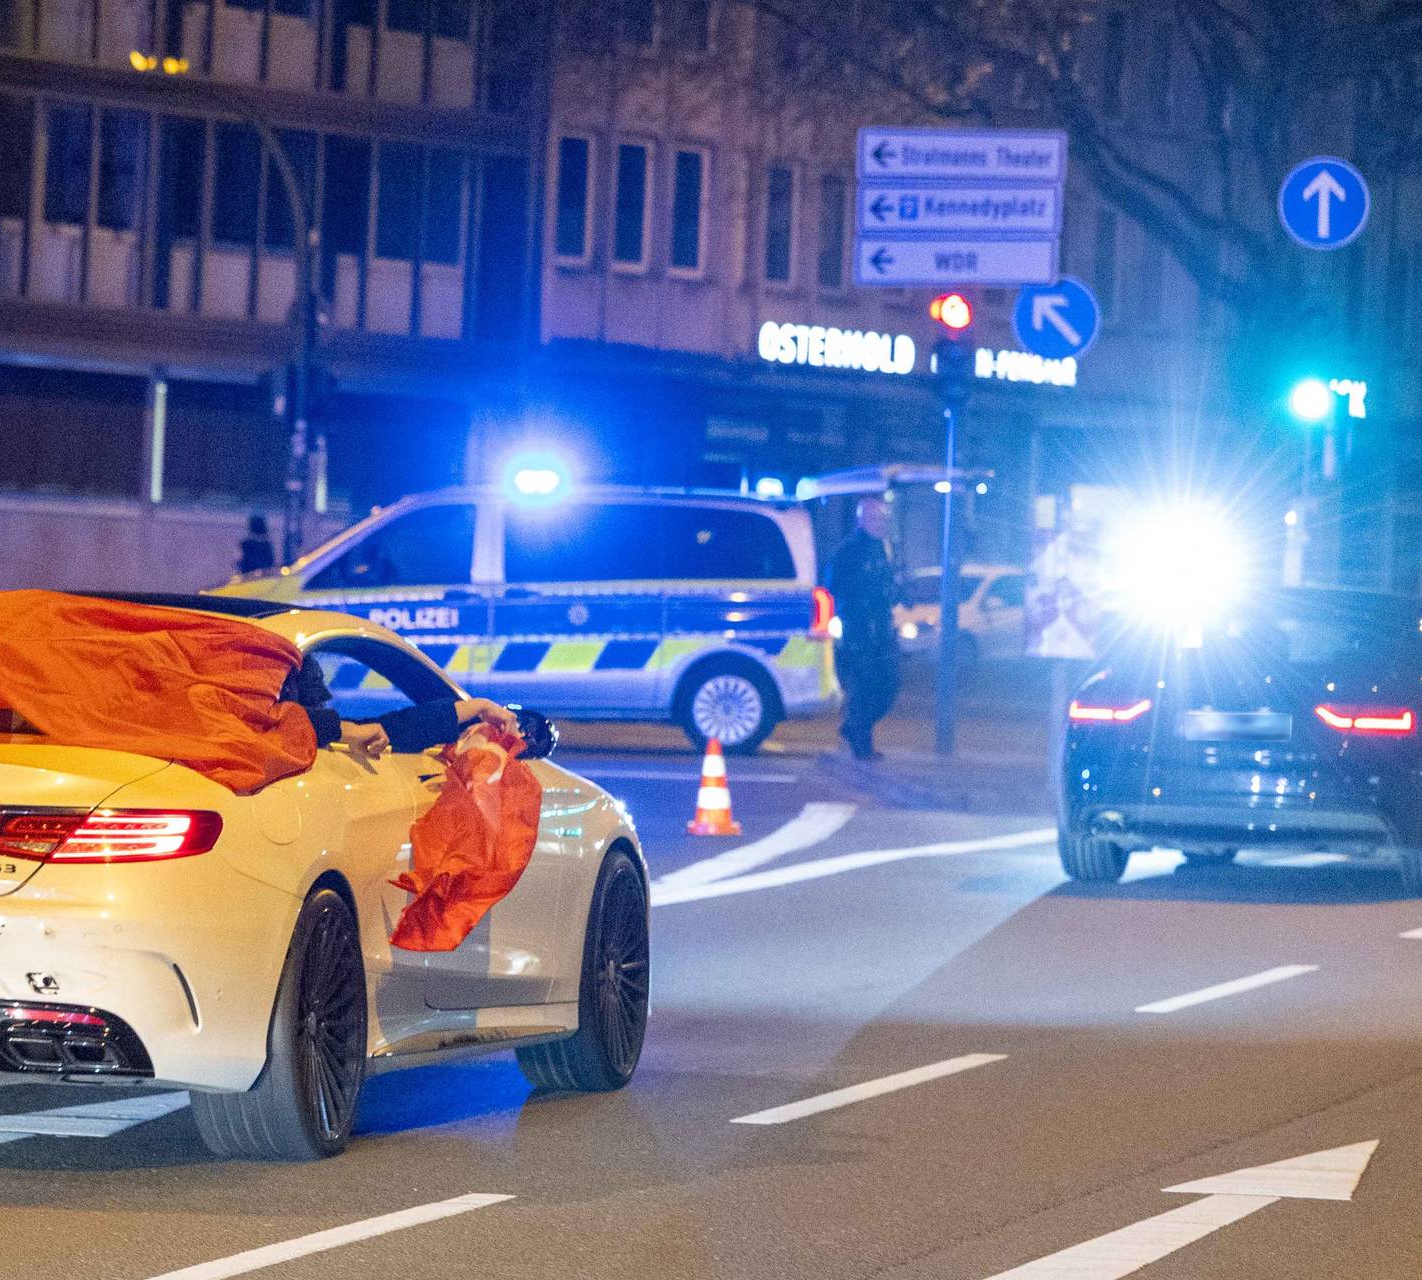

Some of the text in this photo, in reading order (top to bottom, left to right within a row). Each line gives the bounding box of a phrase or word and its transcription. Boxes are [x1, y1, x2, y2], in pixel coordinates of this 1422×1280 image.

[996, 147, 1051, 167] Theater
[924, 196, 1046, 219] Kennedyplatz
[368, 607, 459, 630] POLIZEI
